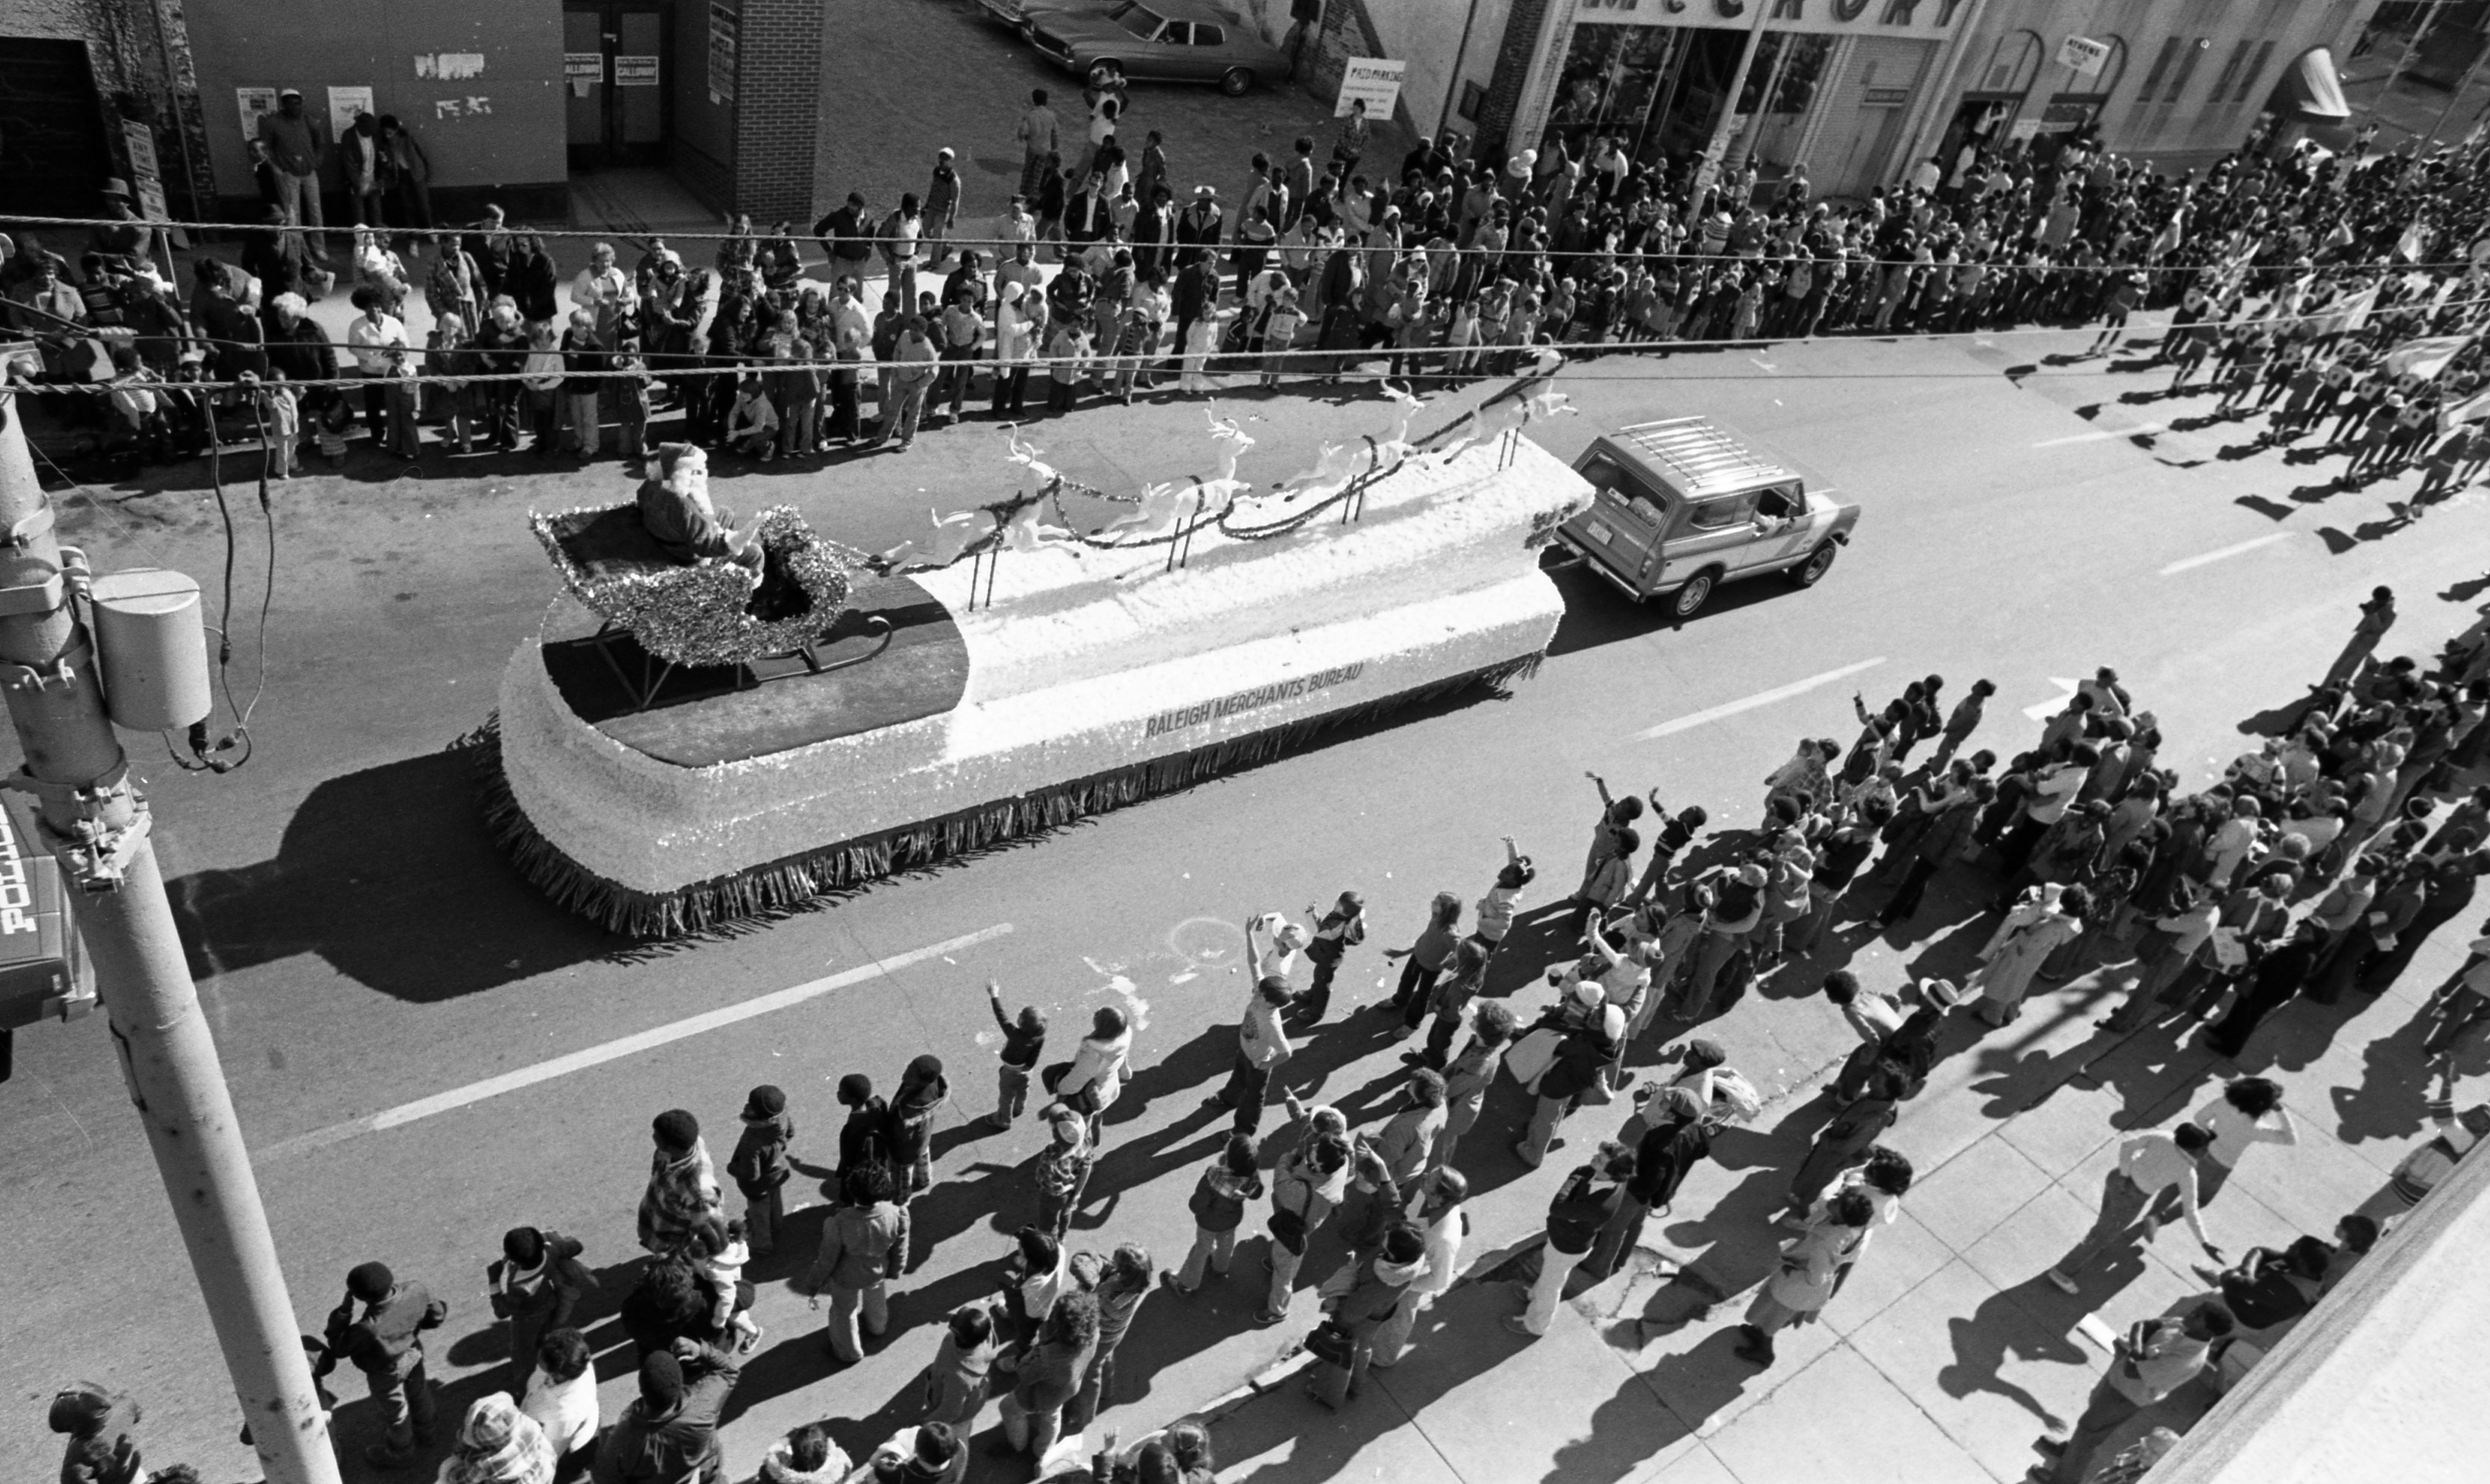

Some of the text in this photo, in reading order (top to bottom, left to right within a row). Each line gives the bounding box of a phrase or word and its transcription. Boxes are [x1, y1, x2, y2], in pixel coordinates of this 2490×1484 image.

[1145, 663, 1364, 738] RALEIGH MERCHANTS BUREAU
[0, 803, 37, 934] POLI
